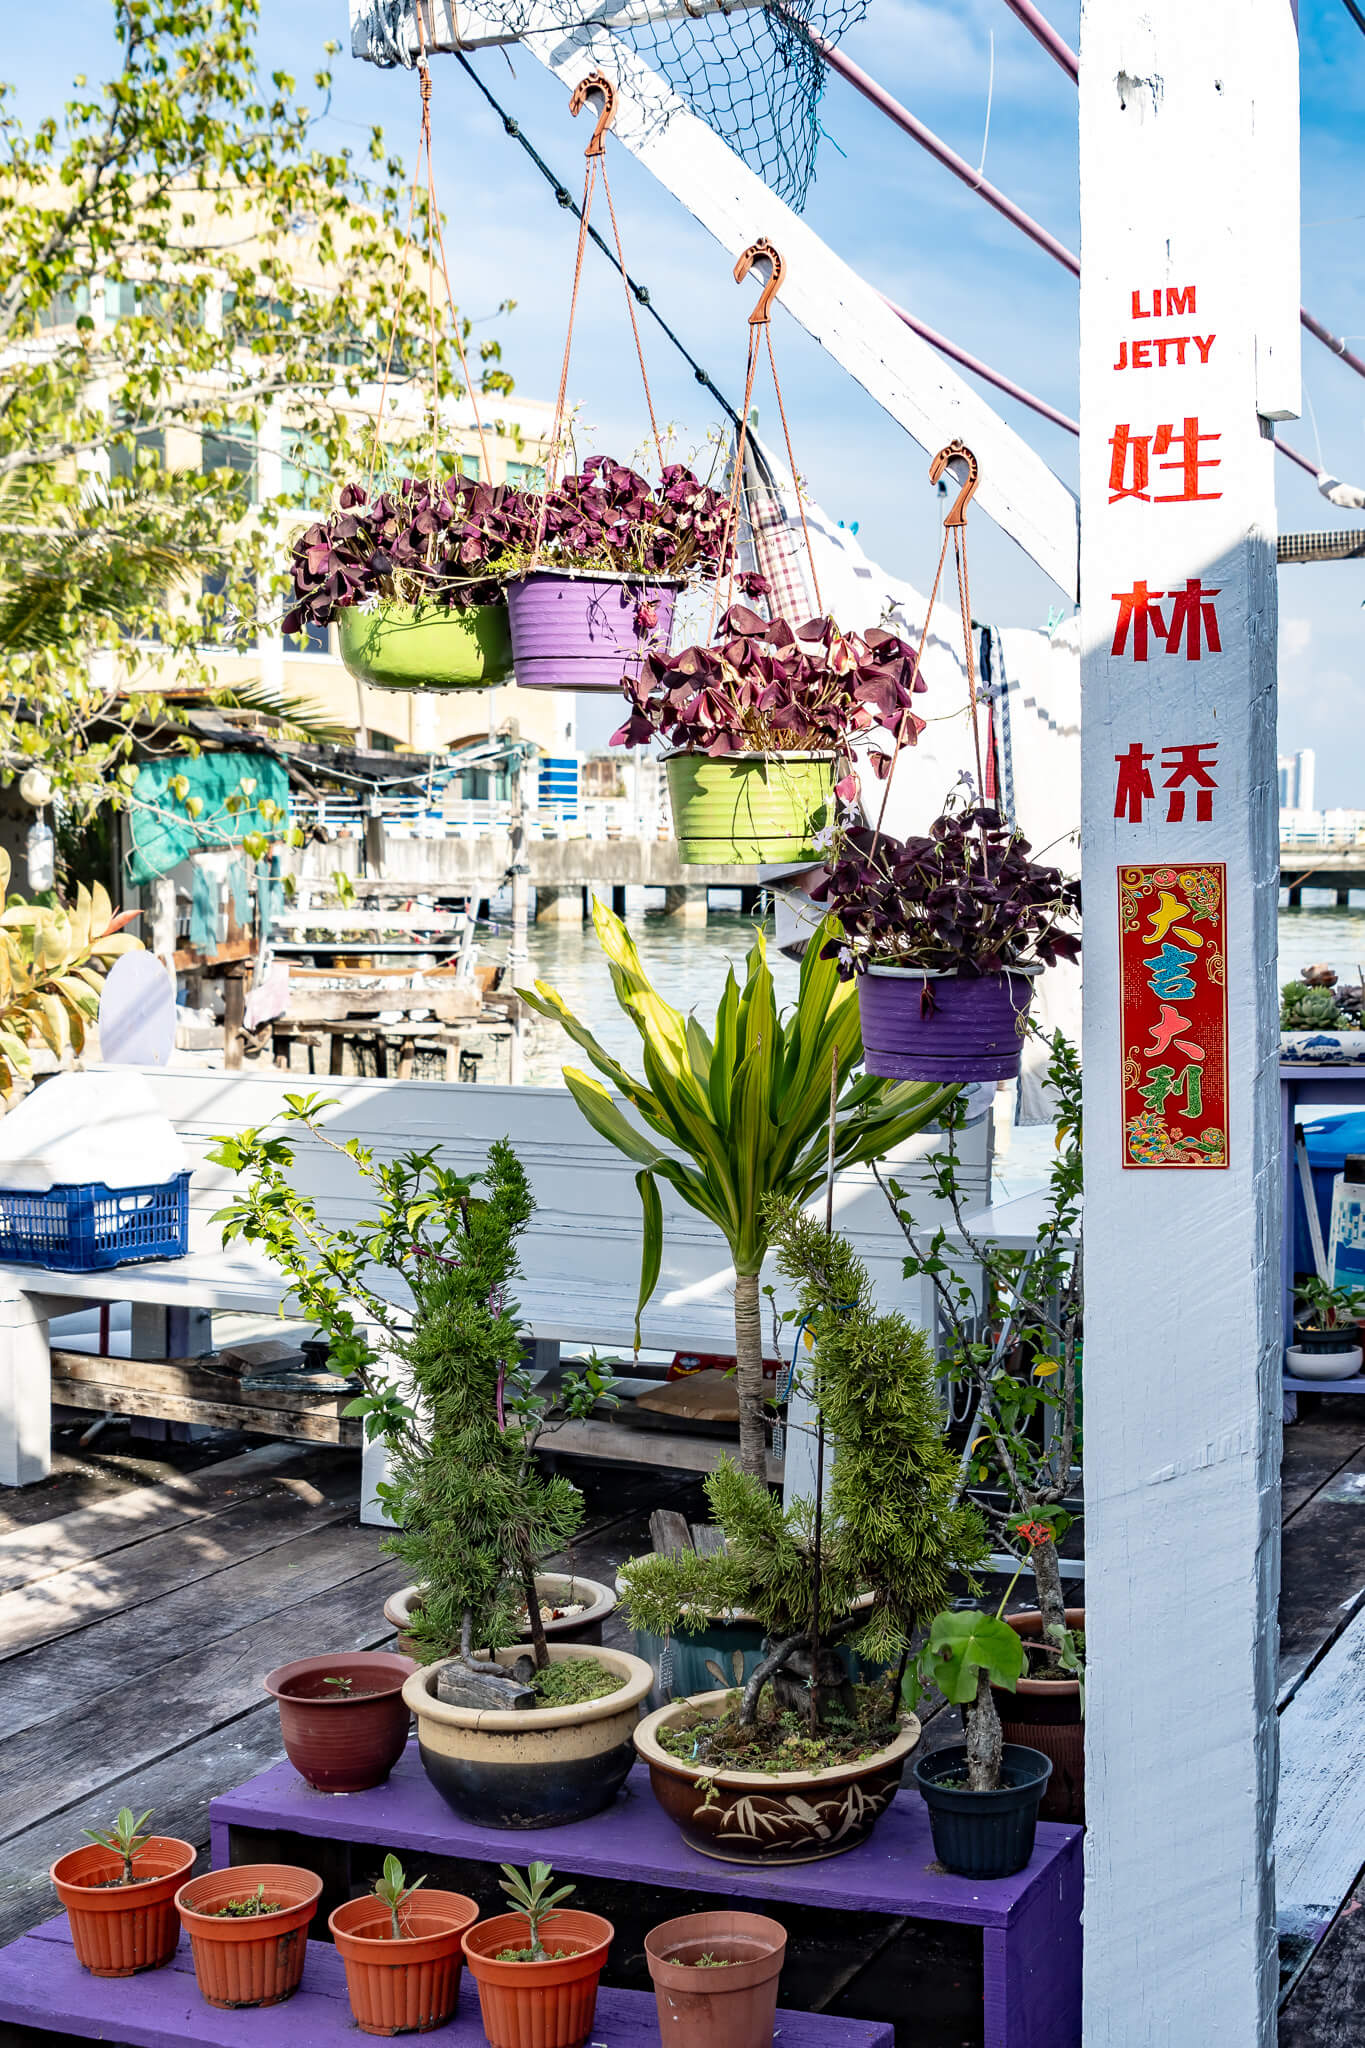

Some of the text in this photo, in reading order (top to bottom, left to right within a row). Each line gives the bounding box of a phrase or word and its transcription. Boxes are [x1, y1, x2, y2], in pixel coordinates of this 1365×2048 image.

[1131, 285, 1197, 320] LIM
[1113, 334, 1217, 371] JETTY
[1137, 890, 1206, 1119] 大吉大利
